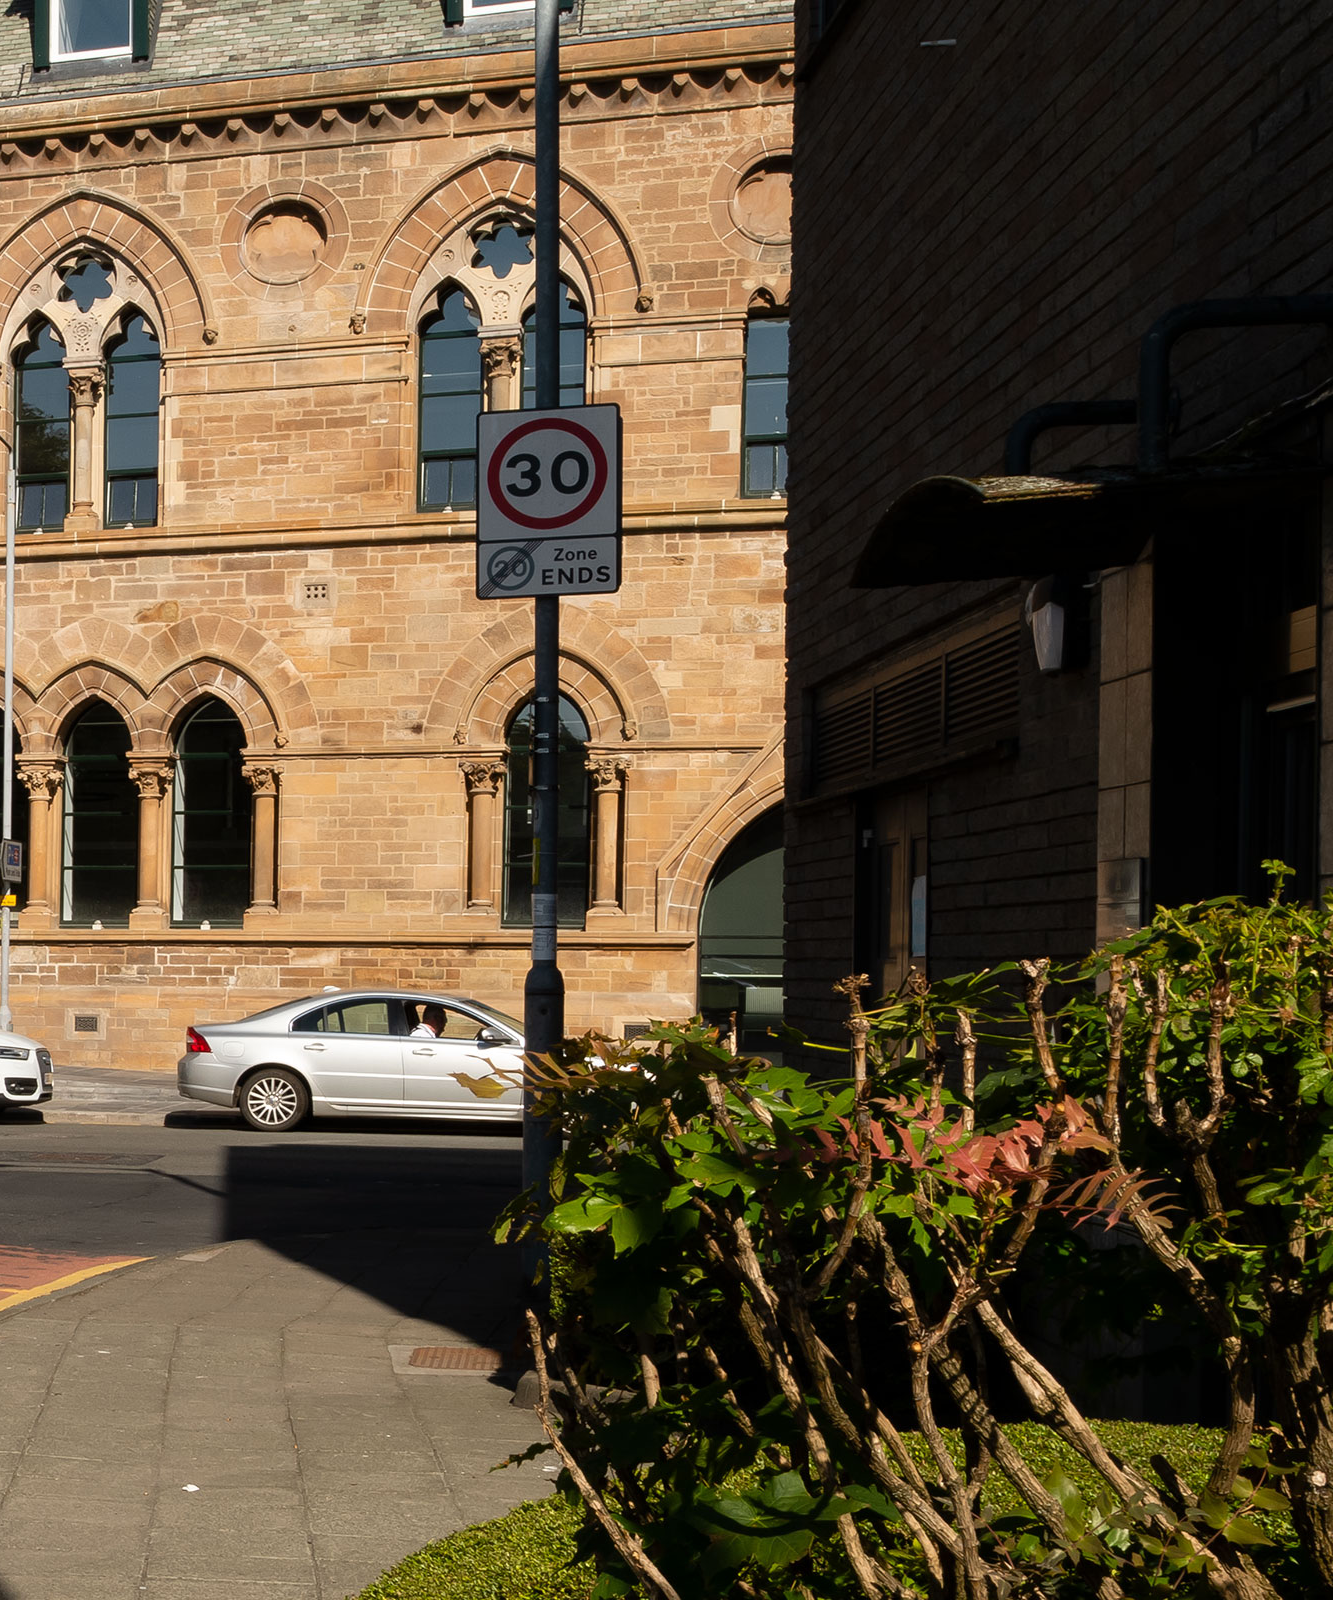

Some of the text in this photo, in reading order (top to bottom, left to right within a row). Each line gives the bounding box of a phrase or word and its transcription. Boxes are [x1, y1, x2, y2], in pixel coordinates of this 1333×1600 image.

[505, 450, 590, 497] 30
[553, 547, 598, 562] Zone
[494, 558, 527, 579] 20
[541, 565, 611, 586] ENDS
